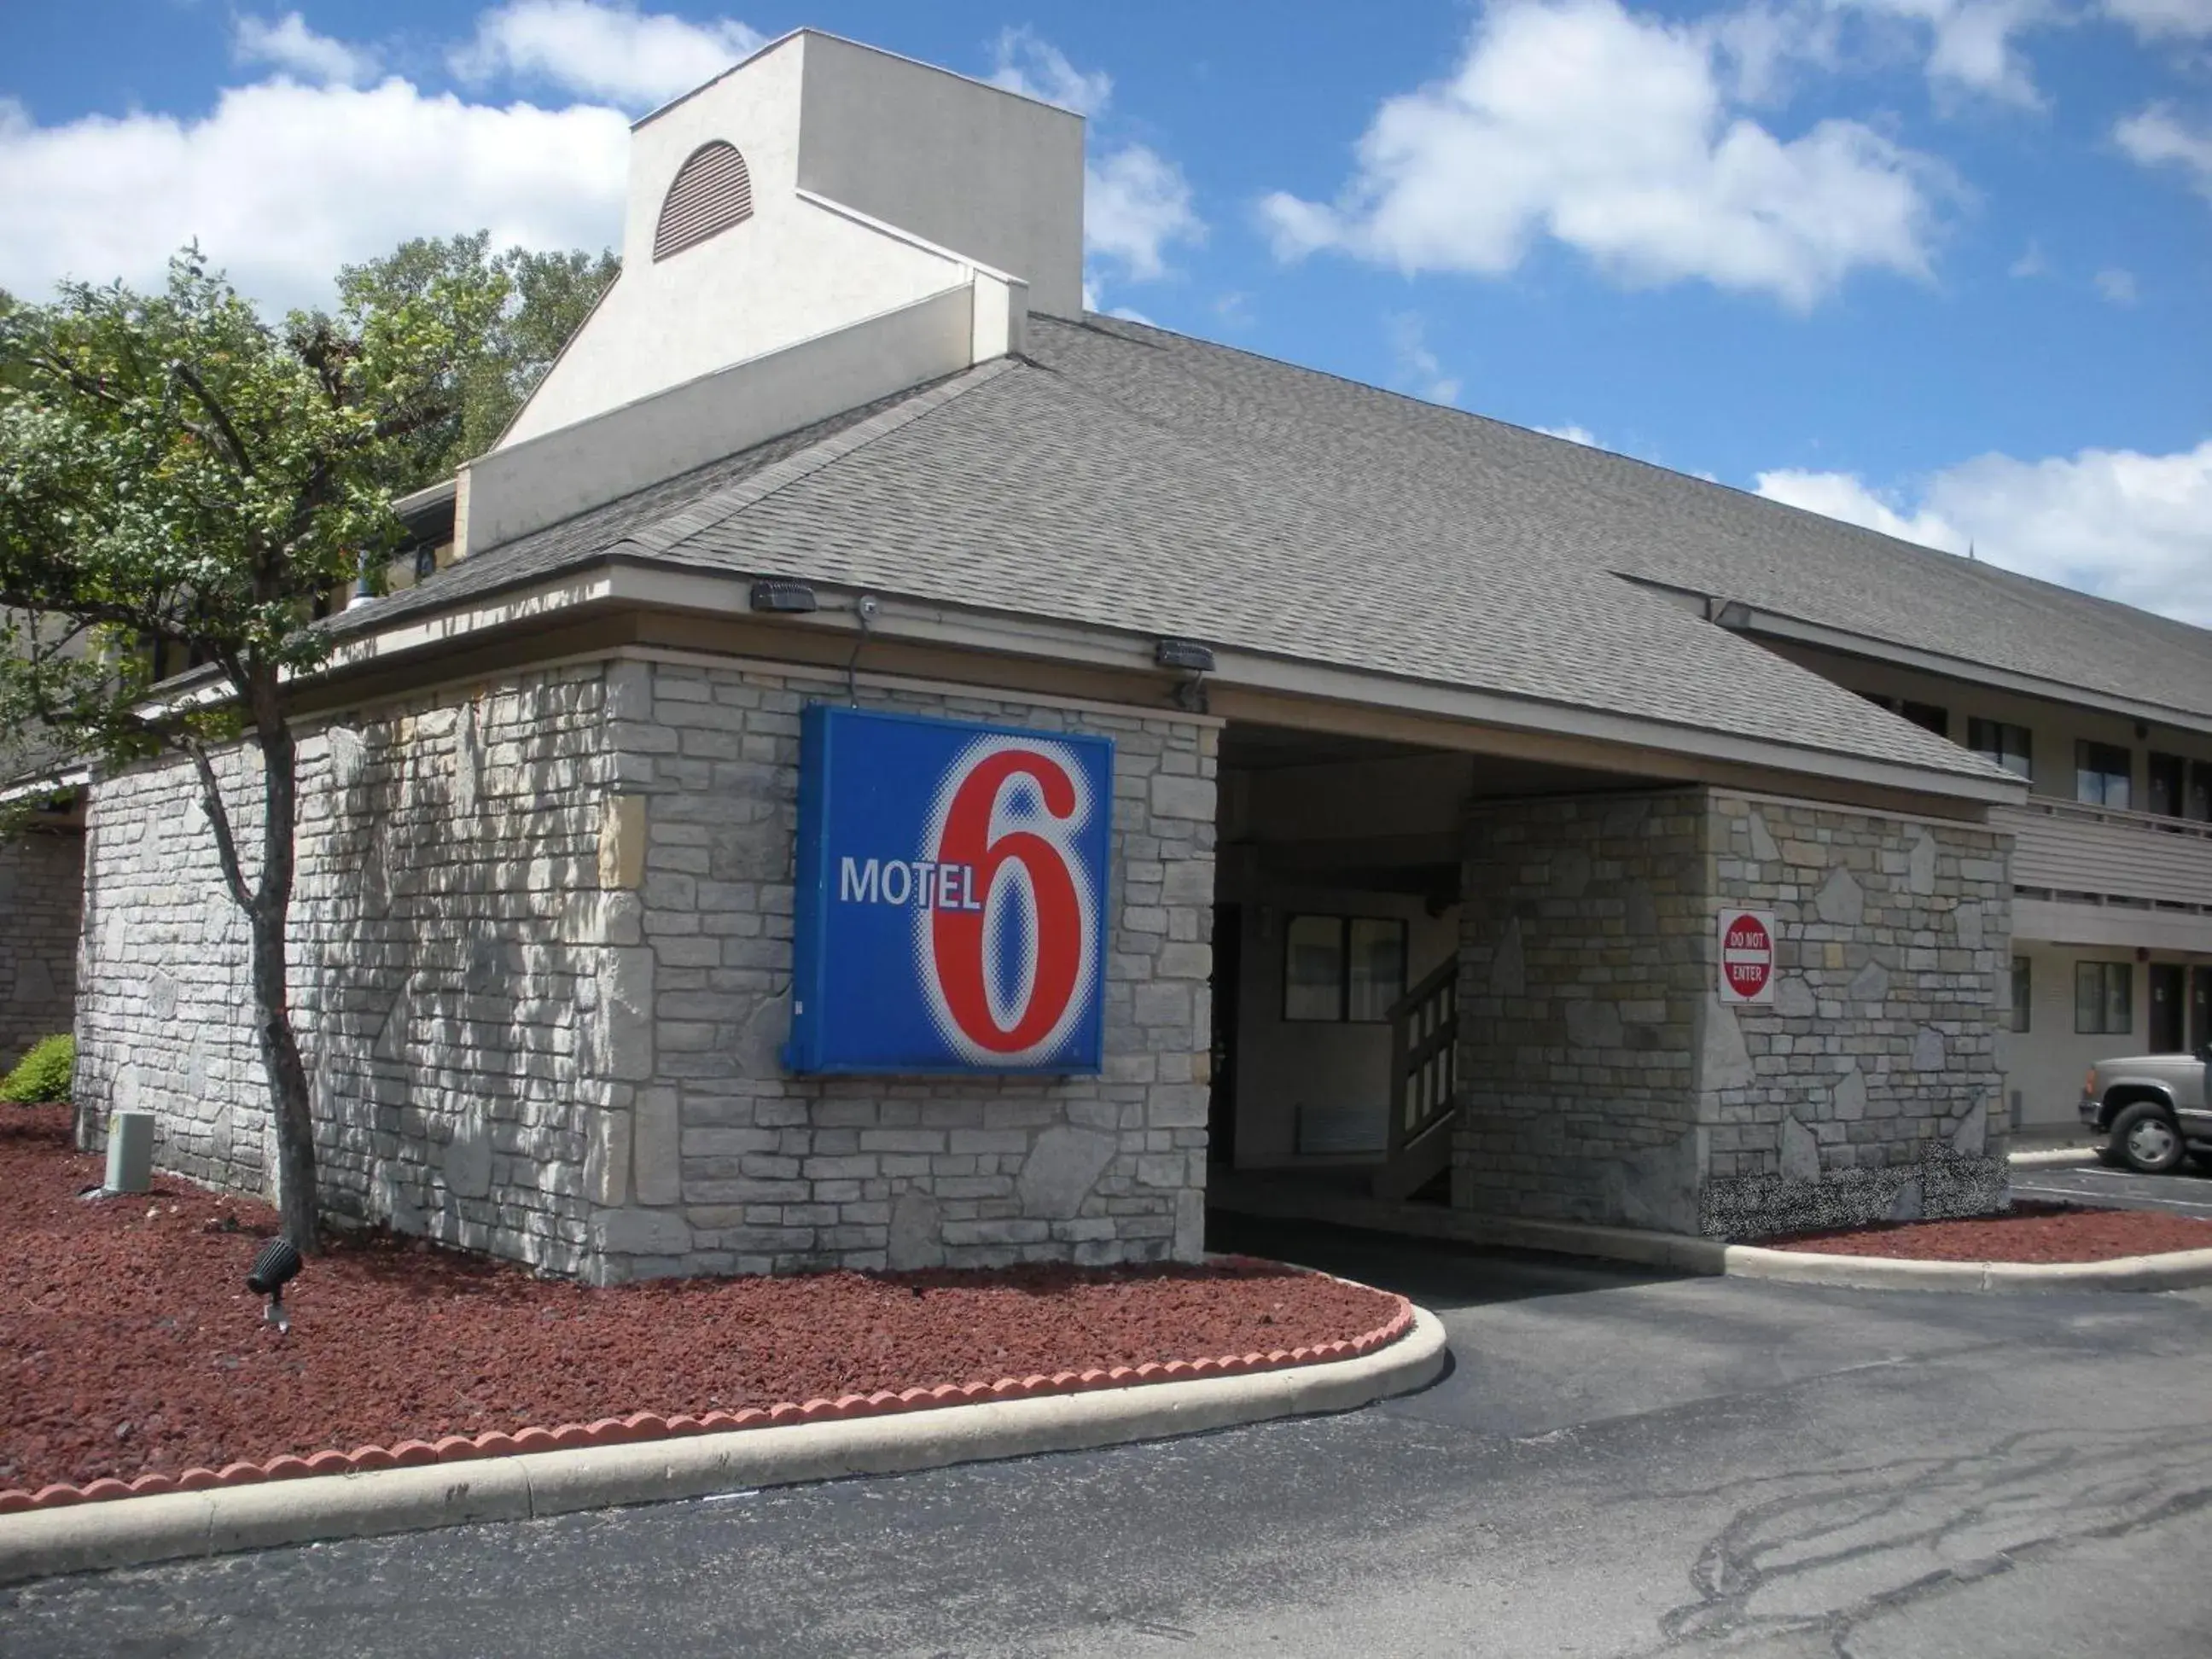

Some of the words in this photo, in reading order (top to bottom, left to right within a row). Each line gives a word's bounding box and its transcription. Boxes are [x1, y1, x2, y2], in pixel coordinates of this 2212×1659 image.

[841, 857, 981, 910] MOTEL
[932, 748, 1083, 1054] 6
[1730, 931, 1743, 946] DO
[1745, 932, 1764, 947] NOT
[1732, 965, 1762, 982] ENTER
